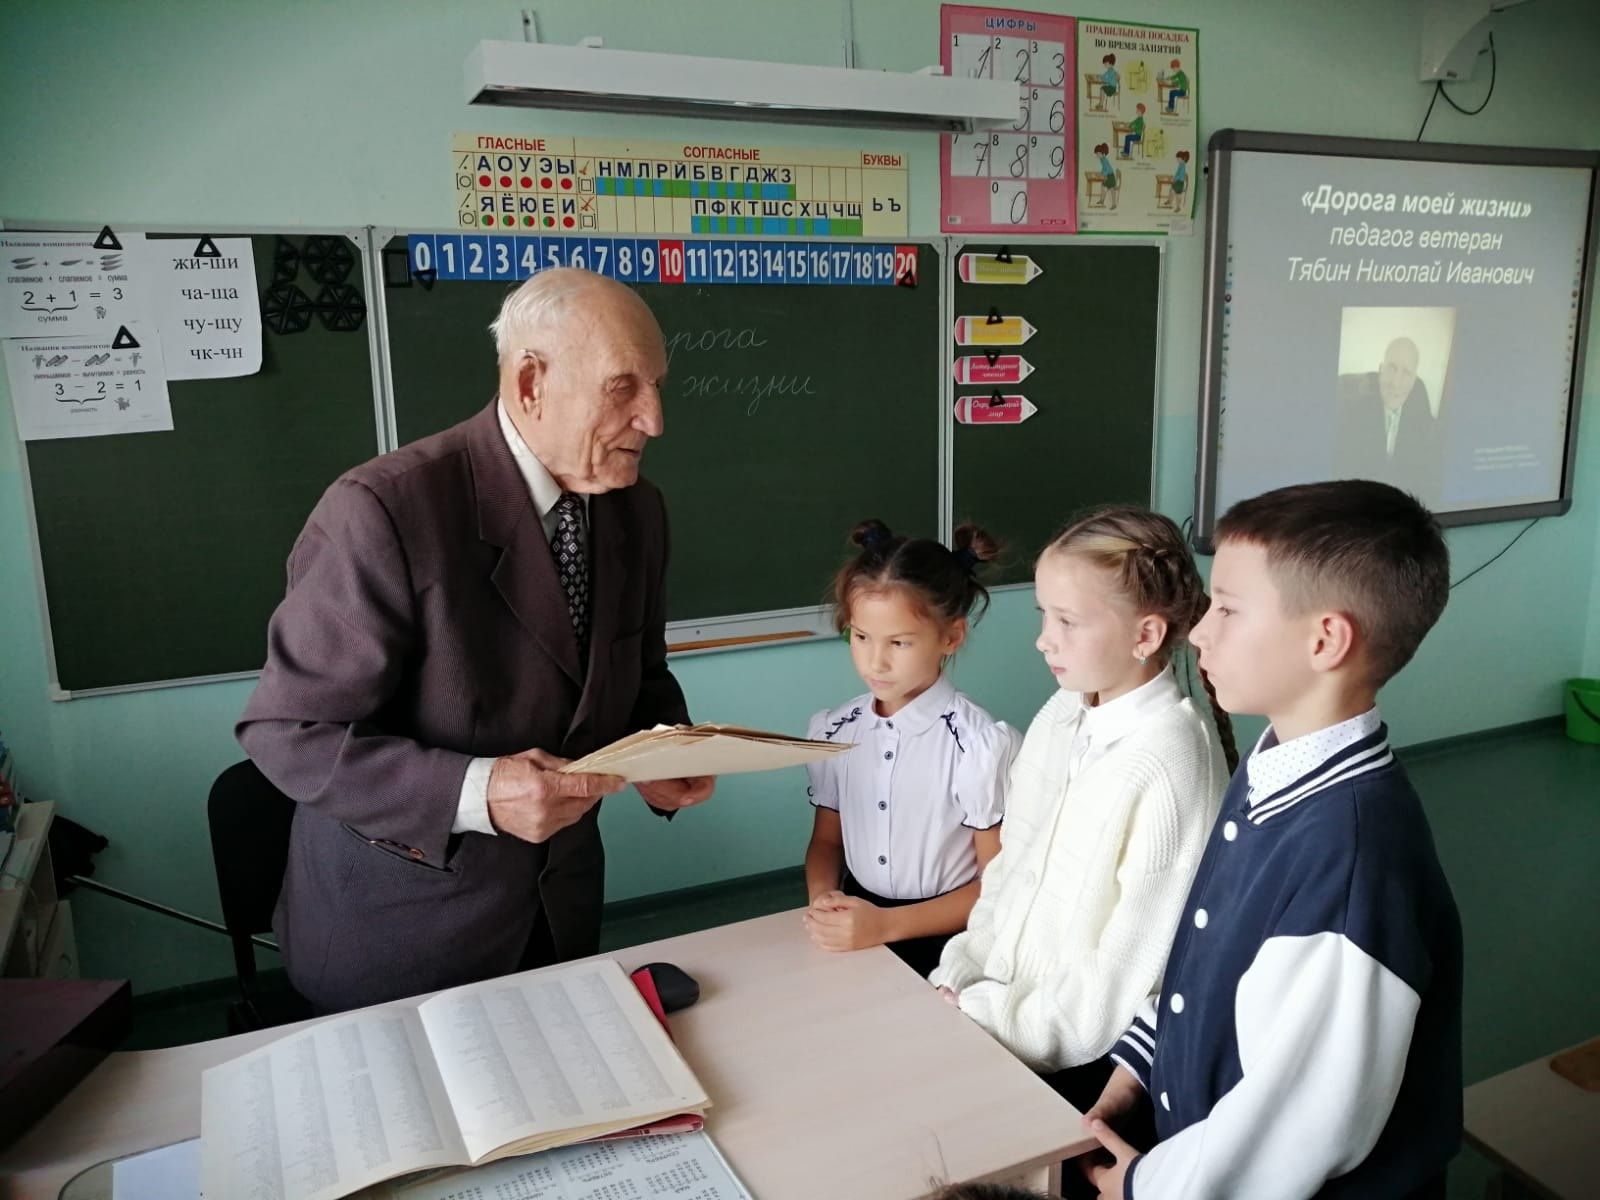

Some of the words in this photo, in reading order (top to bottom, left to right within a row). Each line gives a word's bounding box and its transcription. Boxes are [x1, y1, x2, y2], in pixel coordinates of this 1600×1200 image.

[985, 16, 1036, 32] ЦИФРЫ
[1085, 24, 1146, 39] ПРАВИЛЬНАЯ
[1148, 30, 1190, 43] ПОСАДКА
[953, 35, 959, 46] 1
[995, 38, 1001, 50] 2
[1032, 42, 1038, 53] 3
[1095, 39, 1106, 48] ВО
[1108, 40, 1137, 51] ВРЕМЯ
[1139, 43, 1182, 55] ЗАНЯТИЙ
[978, 47, 991, 79] 1
[1014, 49, 1030, 85] 2
[1049, 53, 1065, 87] 3
[1032, 88, 1038, 100] 6
[1049, 100, 1065, 133] 6
[478, 136, 546, 151] ГЛАСНЫЕ
[992, 134, 999, 146] 8
[1031, 136, 1037, 148] 9
[683, 146, 760, 160] СОГЛАСНЫЕ
[863, 154, 902, 166] БУКВЫ
[974, 142, 989, 177] 7
[1010, 144, 1028, 178] 8
[1048, 146, 1065, 179] 9
[477, 156, 492, 171] А
[498, 156, 512, 172] О
[519, 157, 531, 173] У
[540, 158, 552, 173] Э
[557, 158, 574, 175] Ы
[600, 161, 612, 177] Н
[618, 162, 632, 178] М
[638, 162, 650, 178] Л
[657, 163, 668, 178] Р
[675, 161, 686, 179] Й
[694, 166, 706, 180] Б
[712, 166, 723, 180] В
[730, 167, 740, 181] Г
[746, 168, 759, 183] Д
[762, 168, 778, 182] Ж
[992, 182, 998, 194] 0
[480, 196, 494, 212] Я
[502, 193, 515, 213] Ё
[520, 197, 537, 213] Ю
[543, 198, 554, 214] Е
[562, 199, 575, 214] И
[695, 200, 706, 214] П
[711, 200, 726, 214] Ф
[731, 200, 741, 215] К
[748, 201, 758, 215] Т
[763, 202, 779, 216] Ш
[782, 202, 793, 216] С
[800, 202, 810, 216] Х
[816, 203, 828, 219] Ц
[833, 203, 844, 217] Ч
[847, 204, 862, 220] Щ
[1010, 191, 1028, 224] 0
[1301, 184, 1396, 215] «Дорога
[1402, 192, 1455, 216] моей
[1459, 198, 1532, 218] жизни»
[1329, 222, 1414, 248] педагог
[1419, 230, 1503, 254] ветеран
[172, 258, 239, 270] жи-ши
[415, 242, 430, 272] 0
[442, 242, 455, 273] 1
[468, 242, 484, 274] 2
[495, 243, 510, 274] 3
[521, 244, 537, 274] 4
[594, 246, 608, 275] 7
[619, 246, 632, 276] 8
[641, 247, 655, 276] 9
[662, 248, 682, 276] 10
[686, 248, 707, 277] 11
[713, 248, 734, 278] 12
[738, 249, 759, 278] 13
[763, 250, 784, 278] 14
[787, 250, 806, 278] 15
[810, 250, 830, 278] 16
[832, 251, 850, 279] 17
[854, 251, 873, 279] 18
[875, 252, 894, 280] 19
[896, 252, 917, 279] 20
[1287, 256, 1350, 282] Тябин
[1356, 258, 1440, 283] Николай
[1446, 263, 1535, 284] Иванович
[23, 290, 36, 305] 2
[69, 290, 76, 302] 1
[112, 287, 124, 301] 3
[182, 287, 240, 300] ча-ща
[38, 315, 68, 324] сумма
[184, 318, 242, 335] чу-щу
[190, 347, 243, 360] чк-чн
[664, 328, 768, 366] рога
[56, 383, 64, 396] 3
[96, 382, 106, 394] 2
[134, 380, 141, 392] 1
[683, 375, 817, 416] жизни
